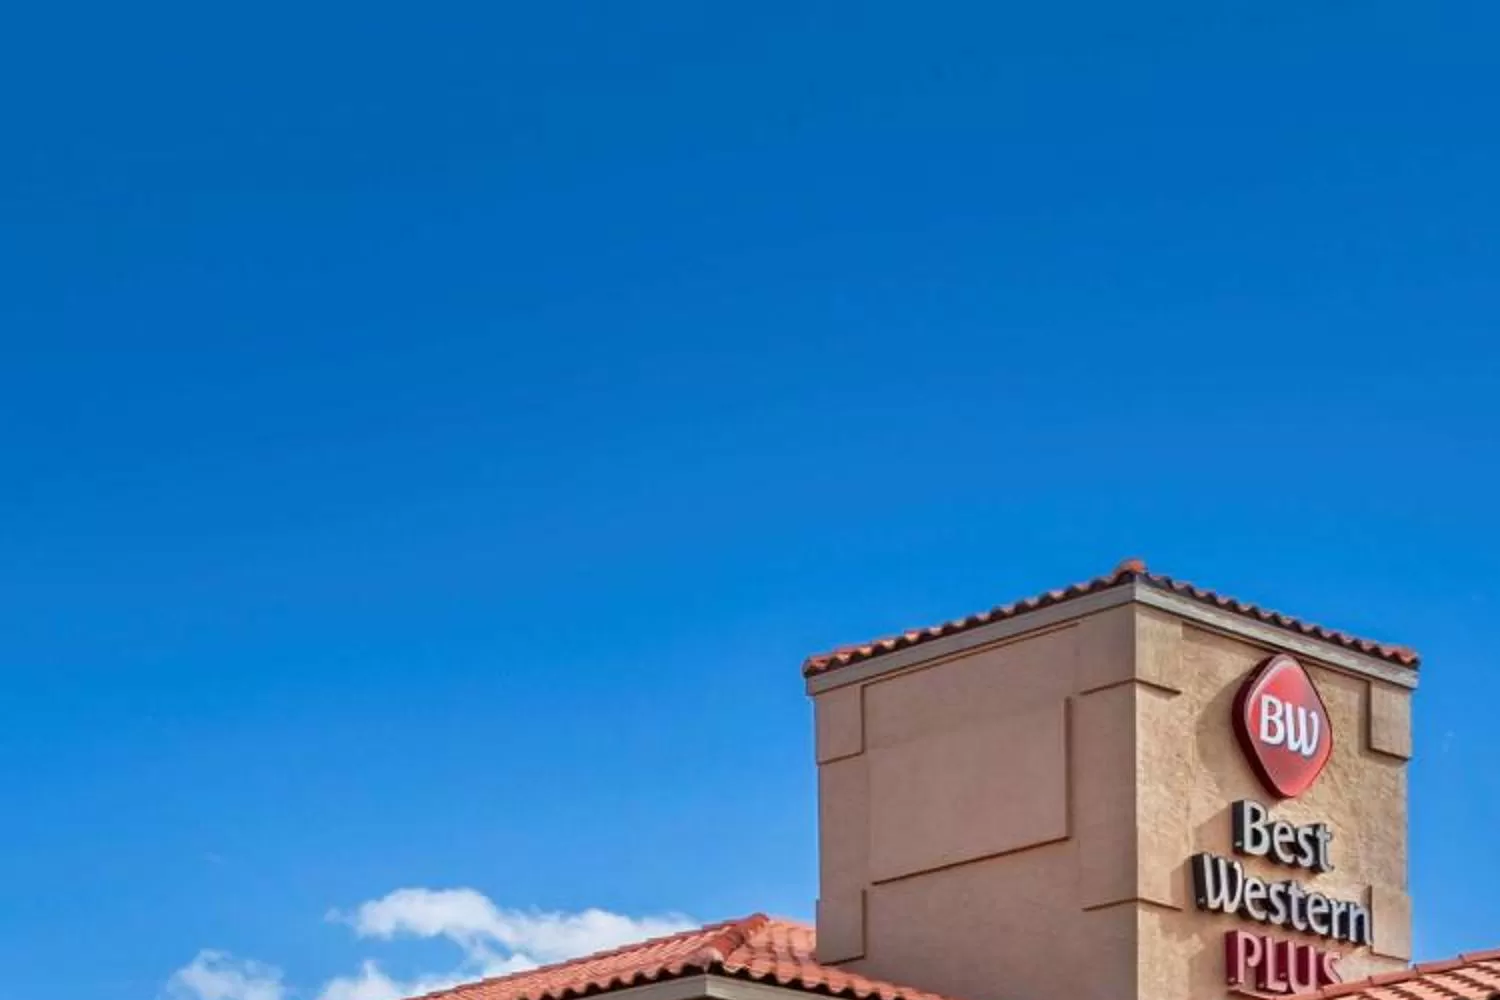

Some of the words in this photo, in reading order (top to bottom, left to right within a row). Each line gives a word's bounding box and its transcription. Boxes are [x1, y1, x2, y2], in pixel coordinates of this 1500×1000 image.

[1259, 693, 1320, 757] BW
[1240, 801, 1334, 872] Best
[1201, 854, 1374, 946] Western
